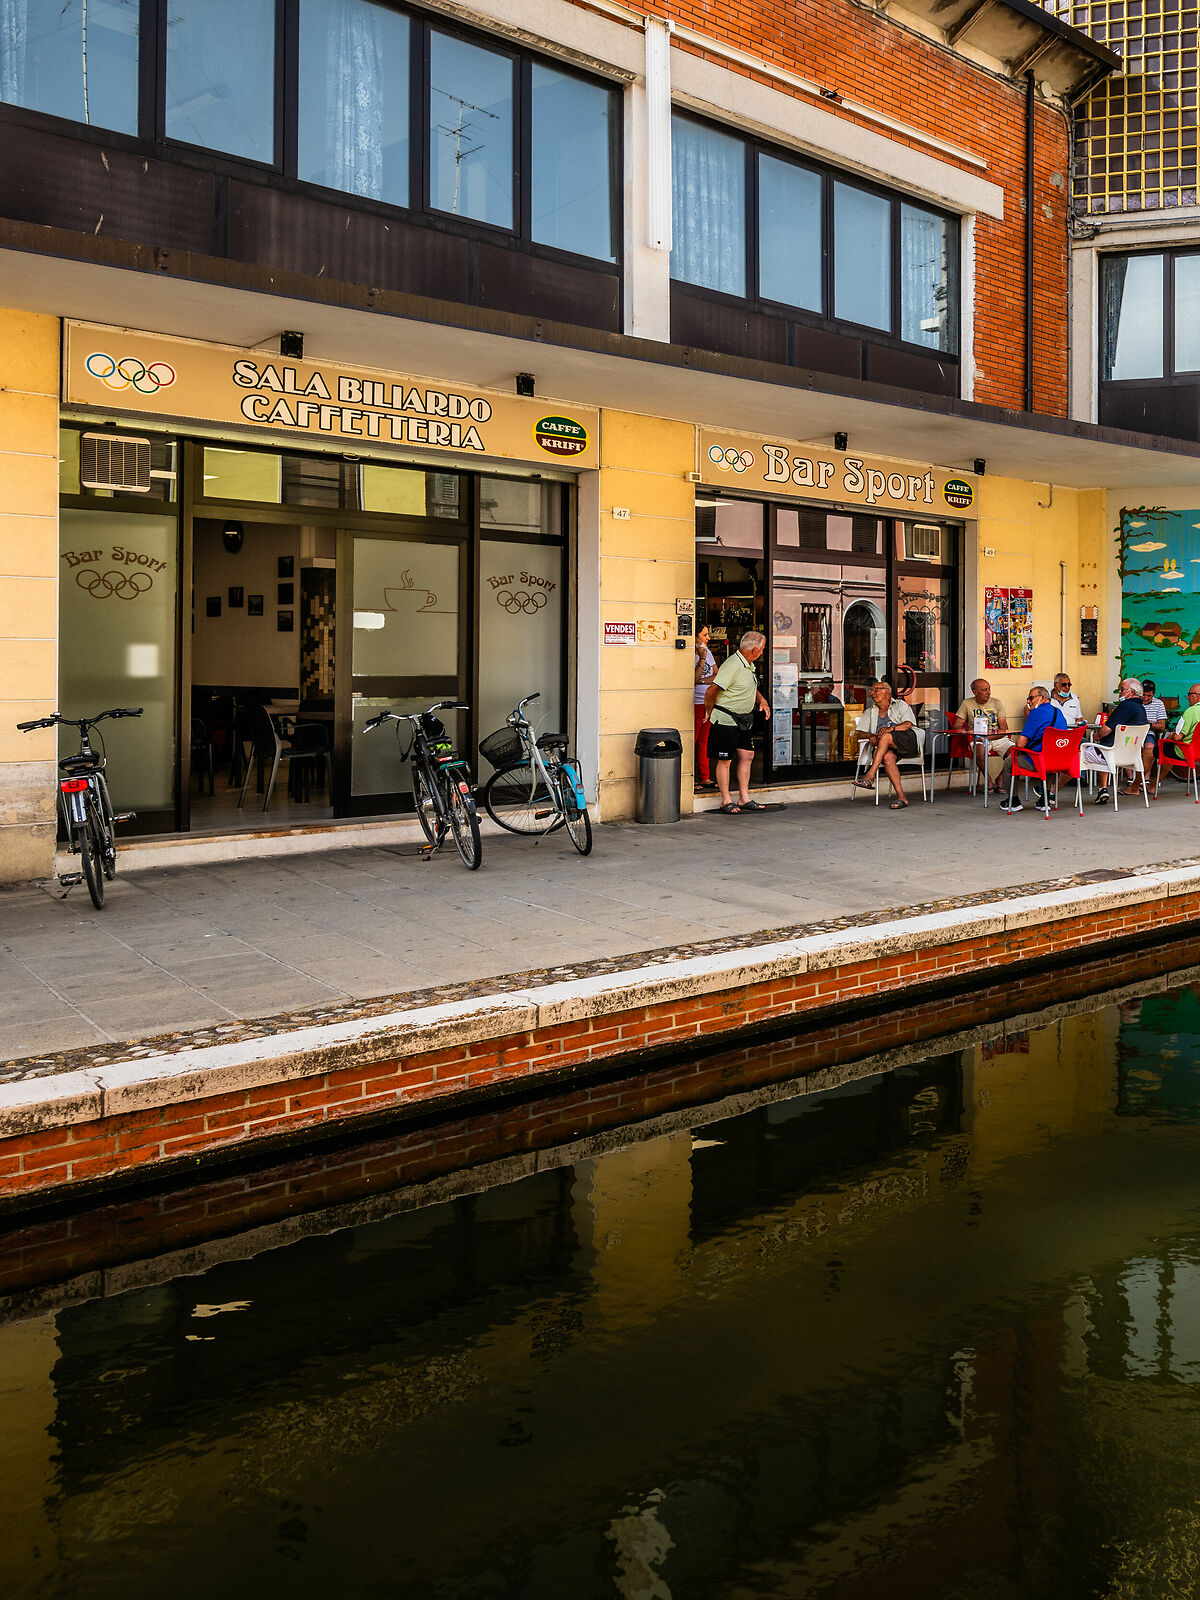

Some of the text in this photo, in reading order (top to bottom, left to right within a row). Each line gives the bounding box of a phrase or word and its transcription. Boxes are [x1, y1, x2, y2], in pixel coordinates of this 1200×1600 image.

[233, 360, 492, 422] SALA BILIARDO
[241, 394, 485, 451] CAFFETTERIA
[541, 438, 581, 451] KRIFI
[762, 444, 935, 503] Bar Sport
[947, 495, 970, 505] KRIFI
[60, 546, 168, 573] Bar Sport
[486, 571, 557, 592] Bar Sport
[604, 624, 635, 634] VENDESI
